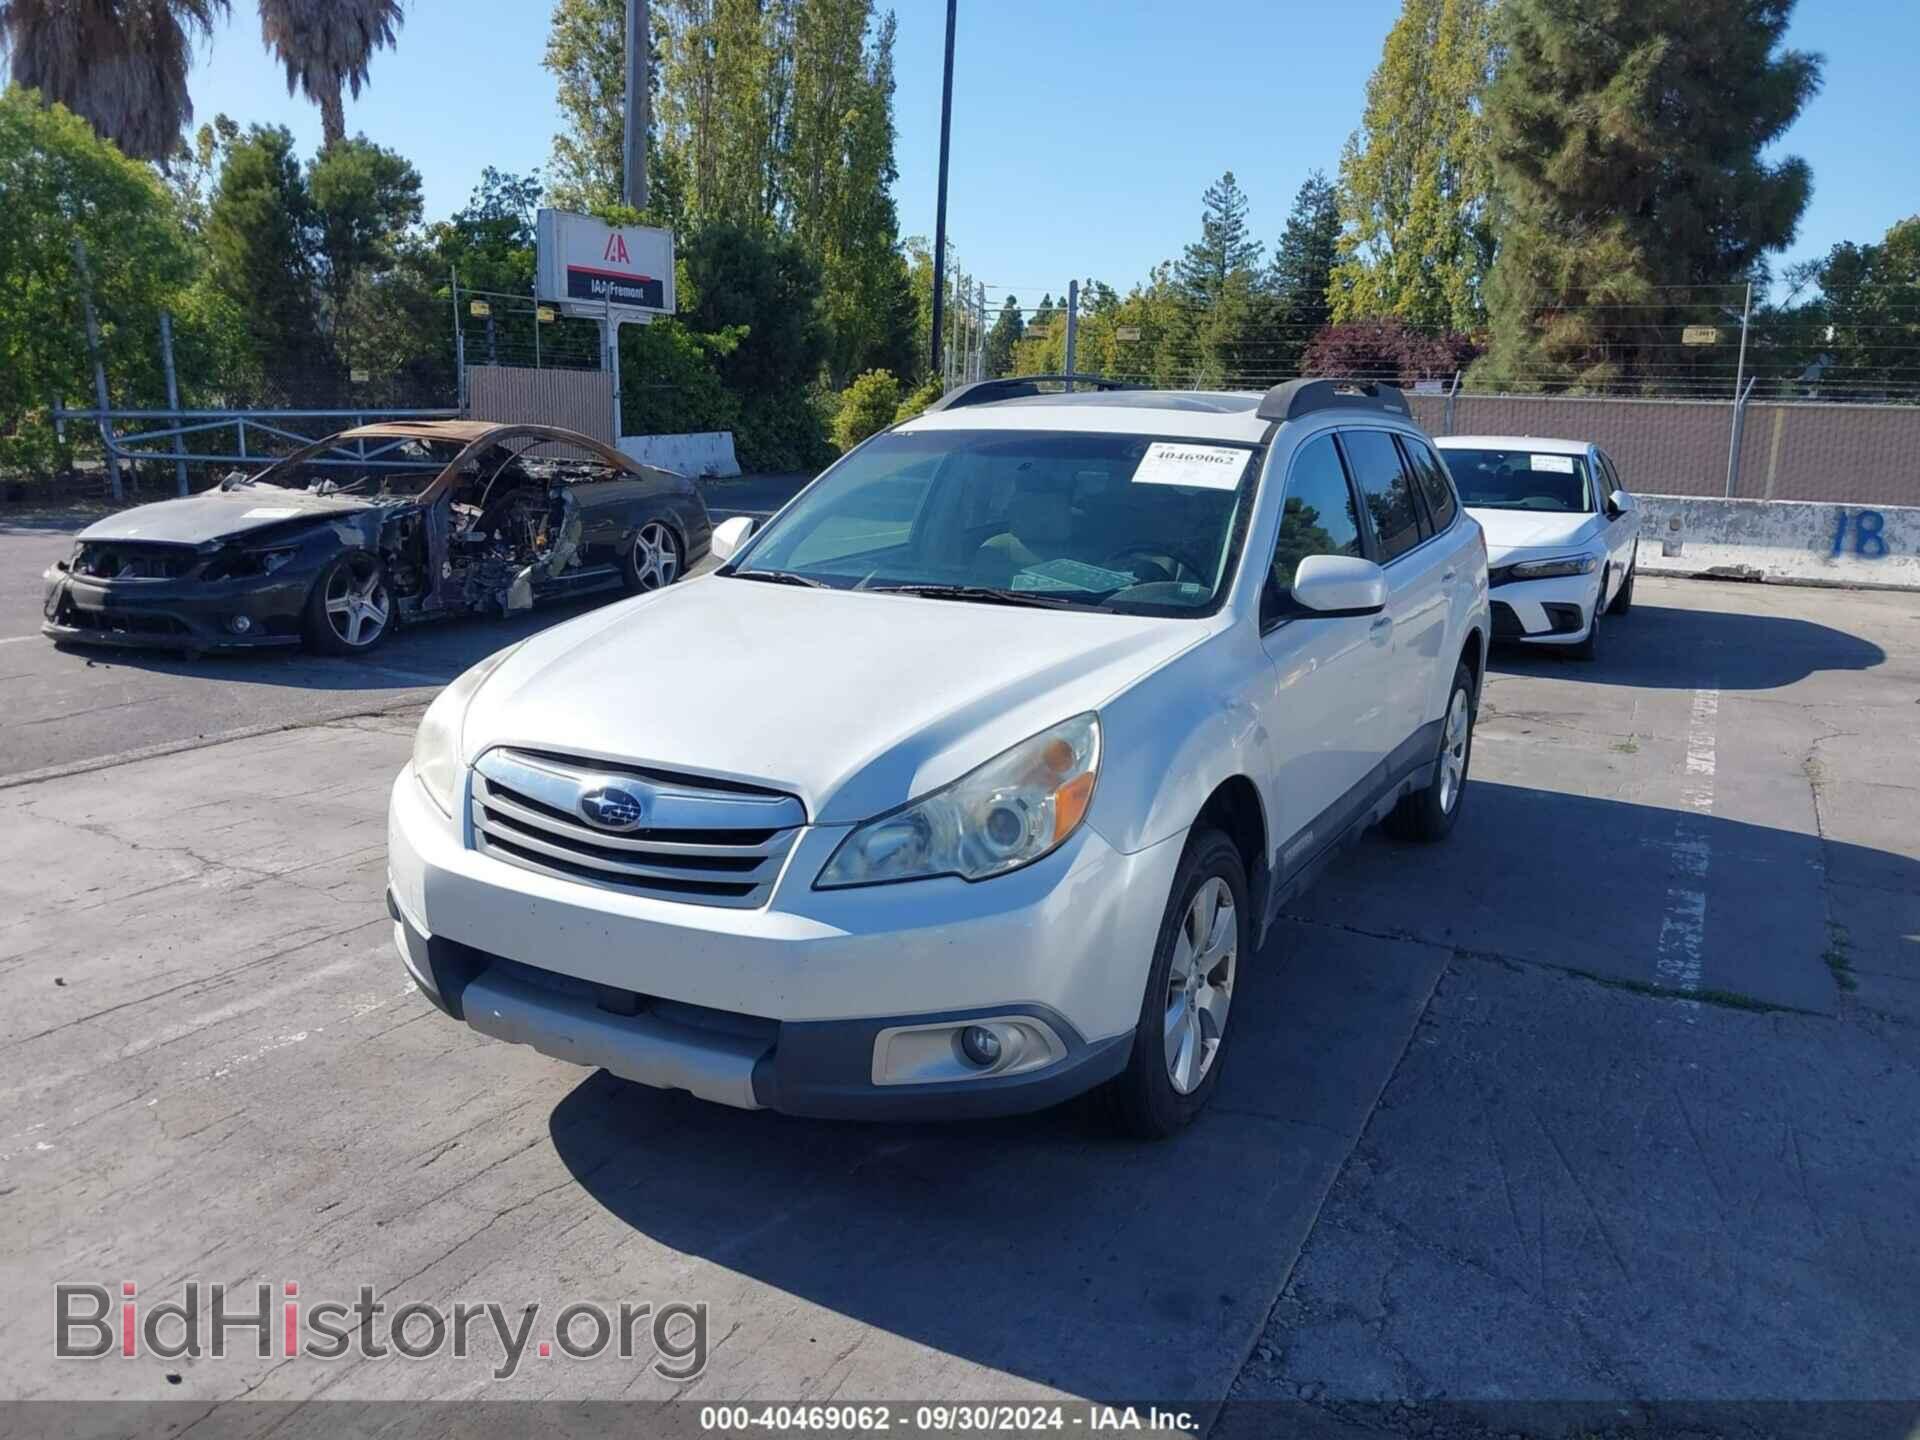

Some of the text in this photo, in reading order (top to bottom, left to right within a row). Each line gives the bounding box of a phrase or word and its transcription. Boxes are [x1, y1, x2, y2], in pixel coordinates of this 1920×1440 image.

[609, 281, 644, 298] Fremont
[1157, 451, 1234, 465] 40469062
[1833, 511, 1888, 559] 18
